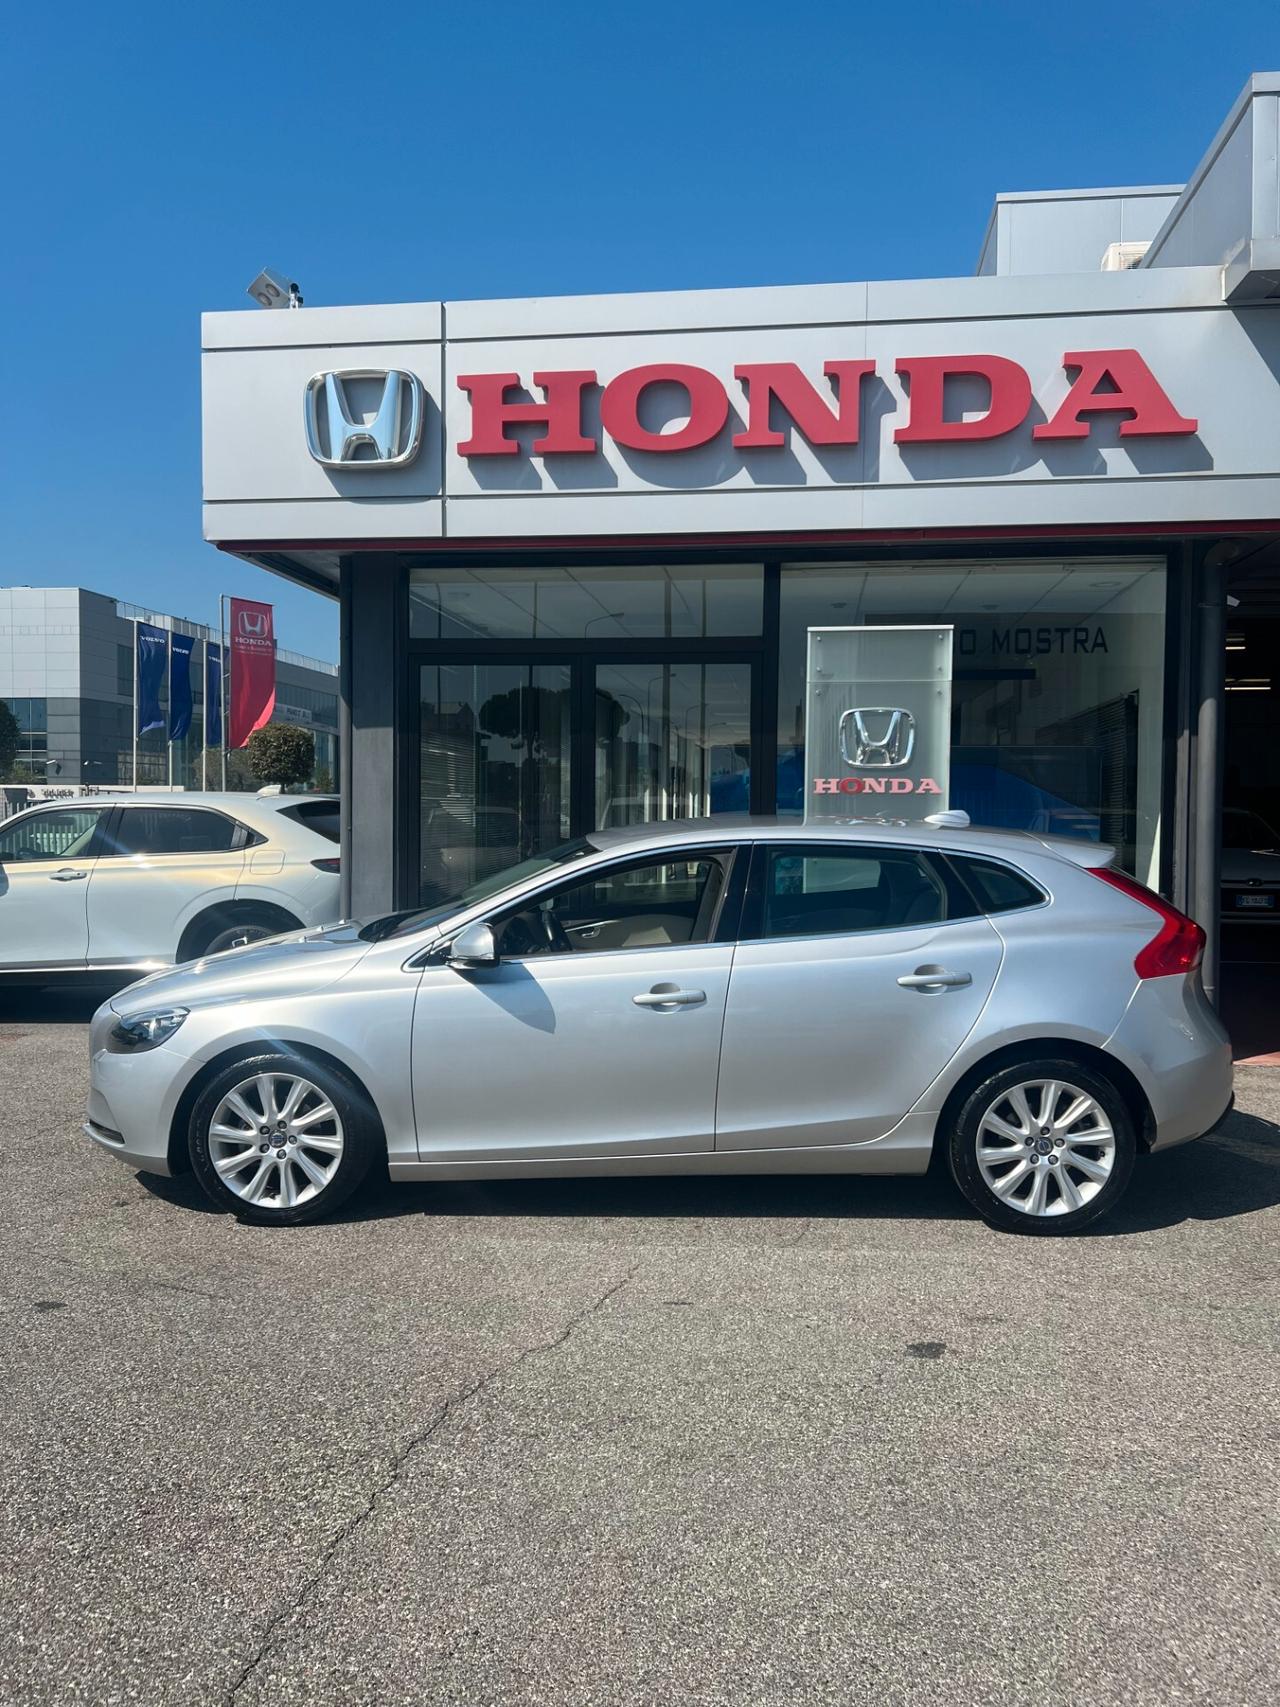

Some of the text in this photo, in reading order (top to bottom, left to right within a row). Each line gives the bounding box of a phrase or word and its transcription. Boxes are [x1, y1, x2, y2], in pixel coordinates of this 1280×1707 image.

[456, 348, 1199, 458] HONDA
[140, 635, 165, 643] VOLVO
[235, 636, 272, 647] HONDA
[993, 626, 1108, 654] MOSTRA
[813, 777, 943, 795] HONDA
